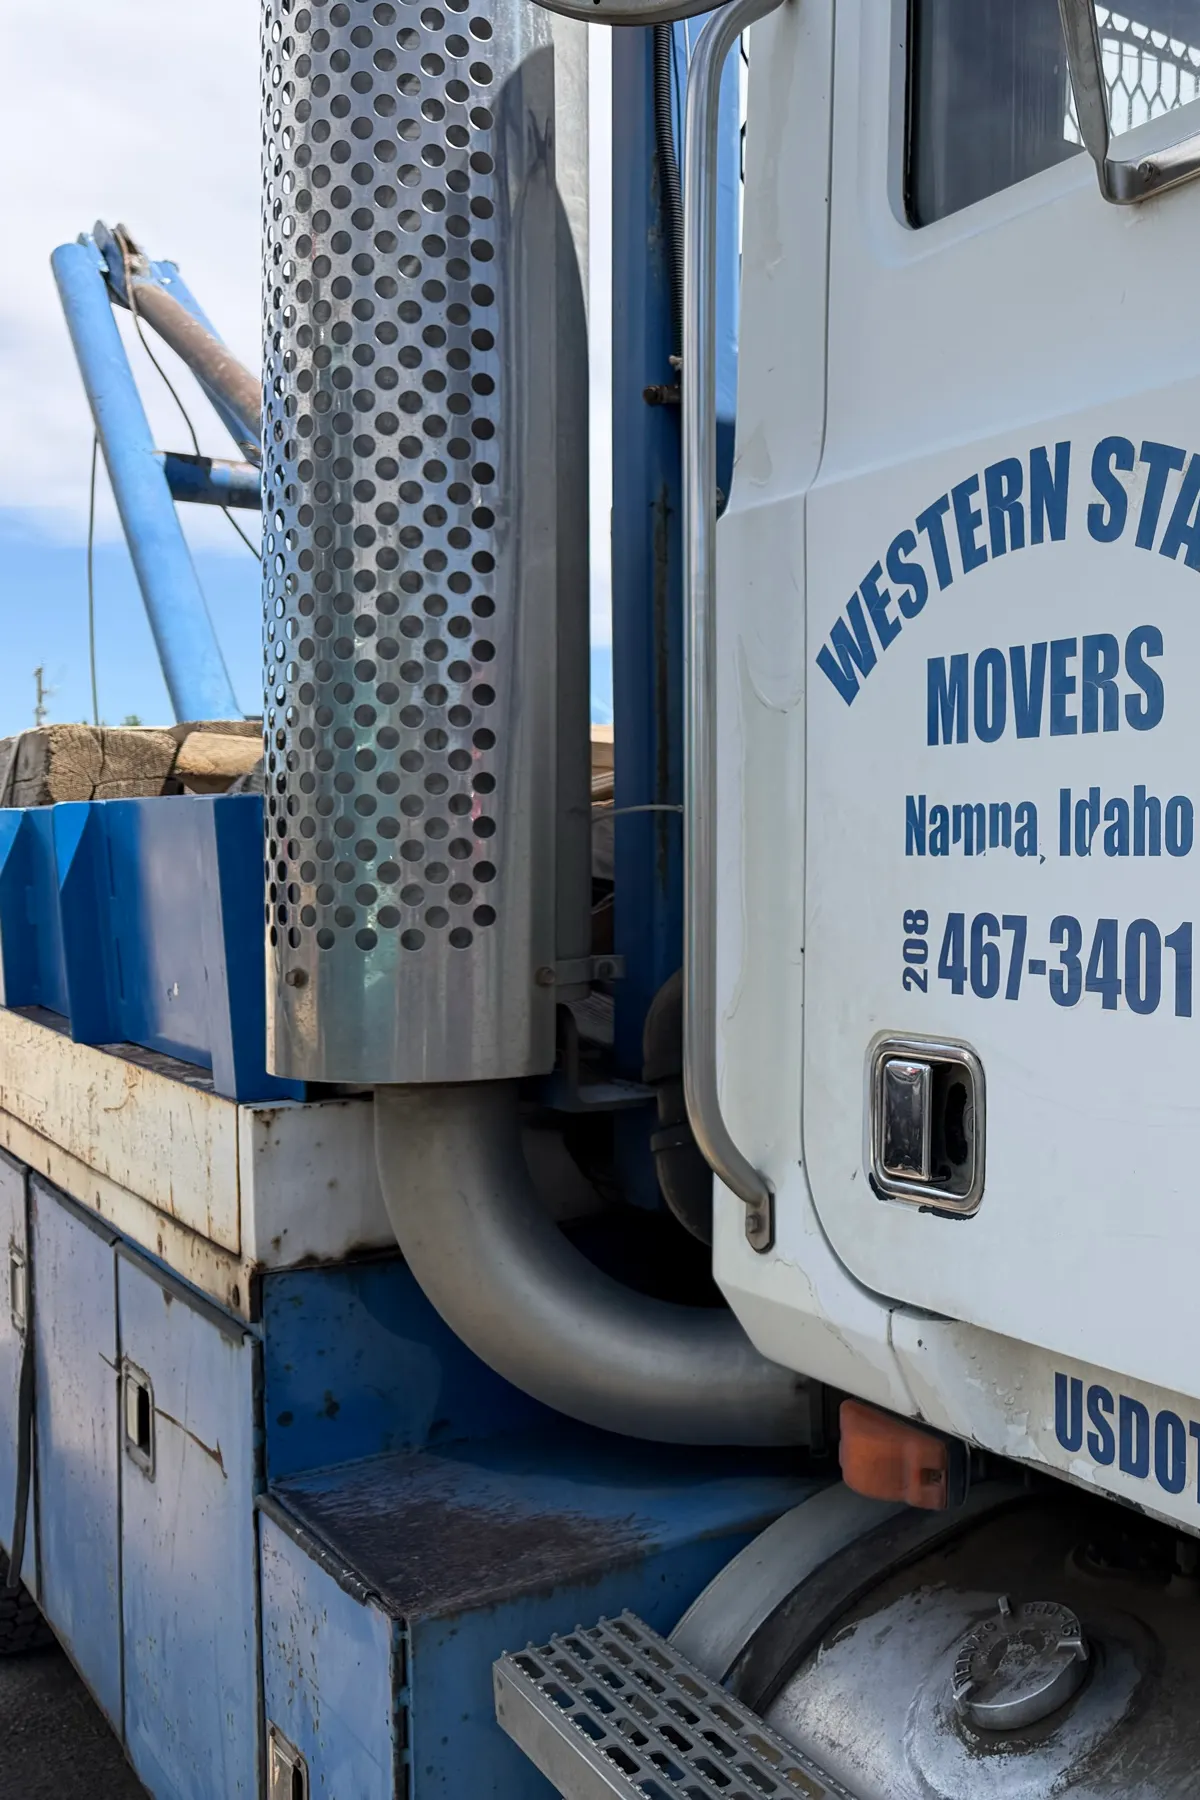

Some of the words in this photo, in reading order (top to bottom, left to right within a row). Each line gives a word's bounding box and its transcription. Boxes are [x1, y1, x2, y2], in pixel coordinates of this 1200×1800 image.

[815, 440, 1071, 706] WESTERN
[927, 625, 1165, 746] MOVERS
[1059, 784, 1194, 857] Idaho
[902, 909, 929, 994] 208
[937, 912, 1193, 1018] 467-3401
